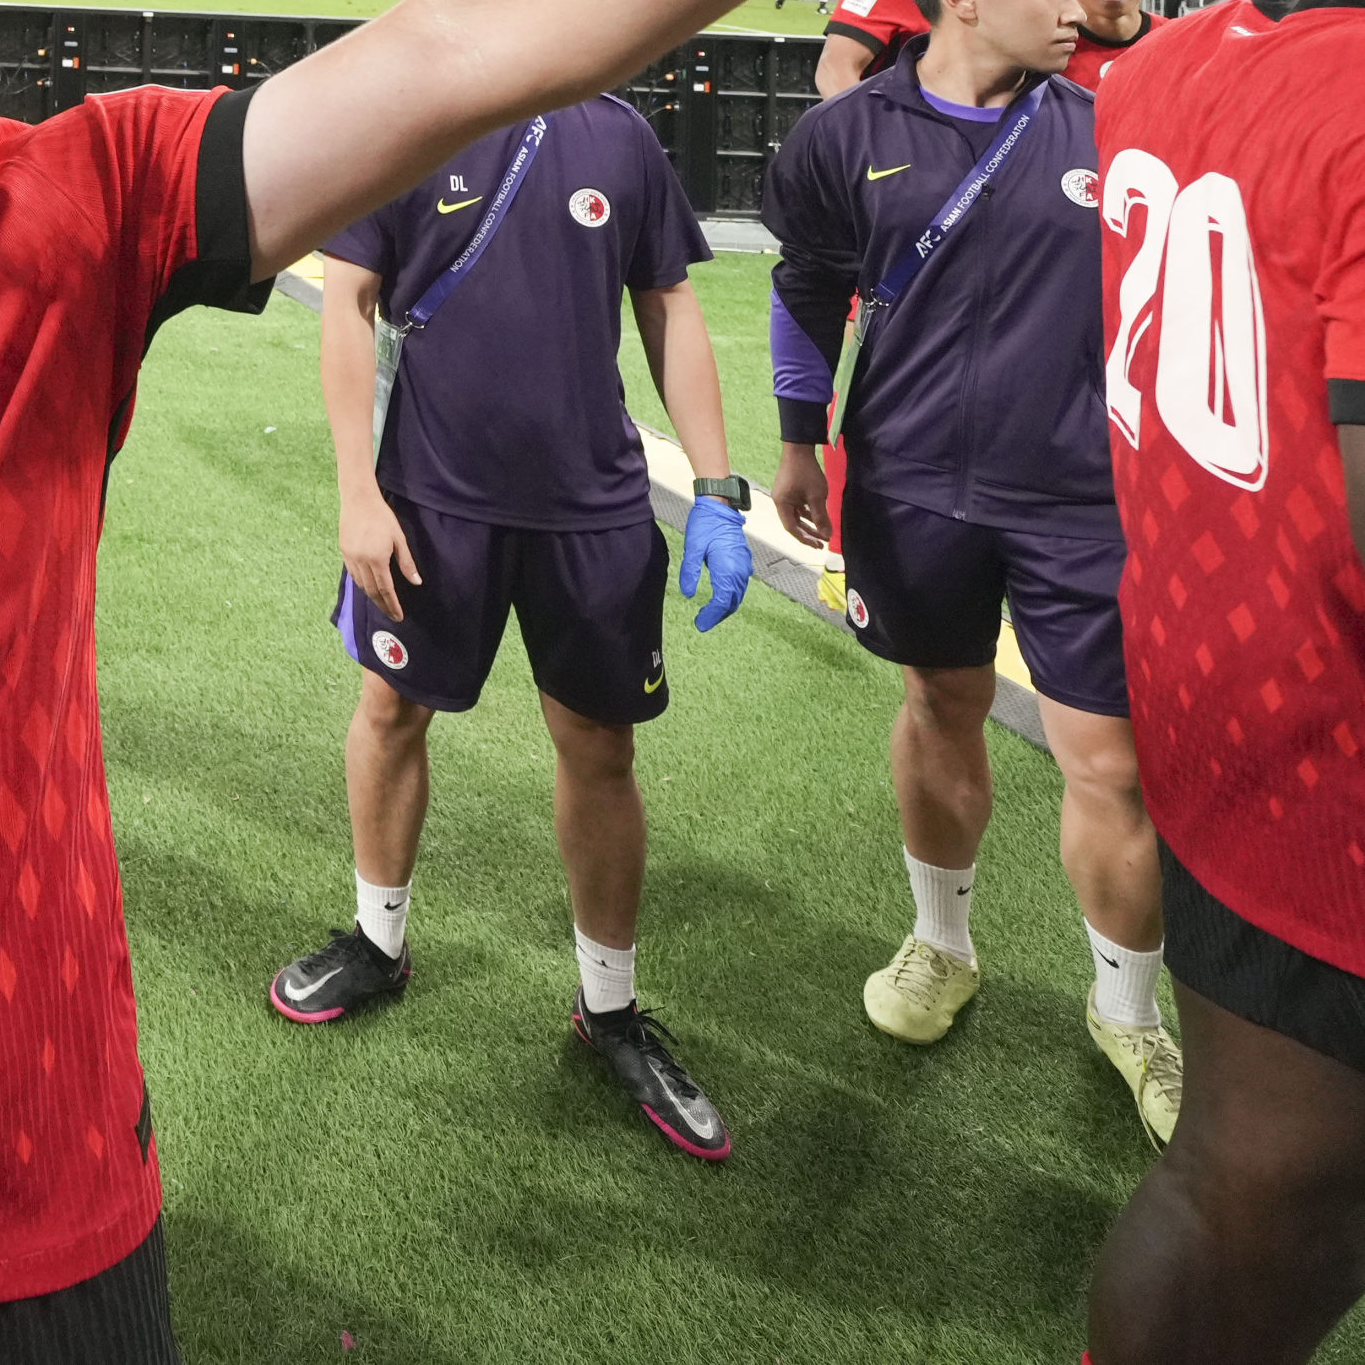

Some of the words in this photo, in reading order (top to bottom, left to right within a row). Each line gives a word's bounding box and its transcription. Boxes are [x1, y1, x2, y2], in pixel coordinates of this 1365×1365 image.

[525, 115, 547, 147] AFC
[512, 146, 529, 173] ASIAN
[449, 175, 468, 192] DL
[490, 171, 516, 211] FOOTBALL
[915, 229, 941, 258] AFC
[940, 207, 962, 233] ASIAN
[960, 172, 990, 210] FOOTBALL
[985, 114, 1030, 173] CONFEDERATION
[450, 210, 496, 273] CONFEDERATION
[1102, 148, 1269, 492] 20
